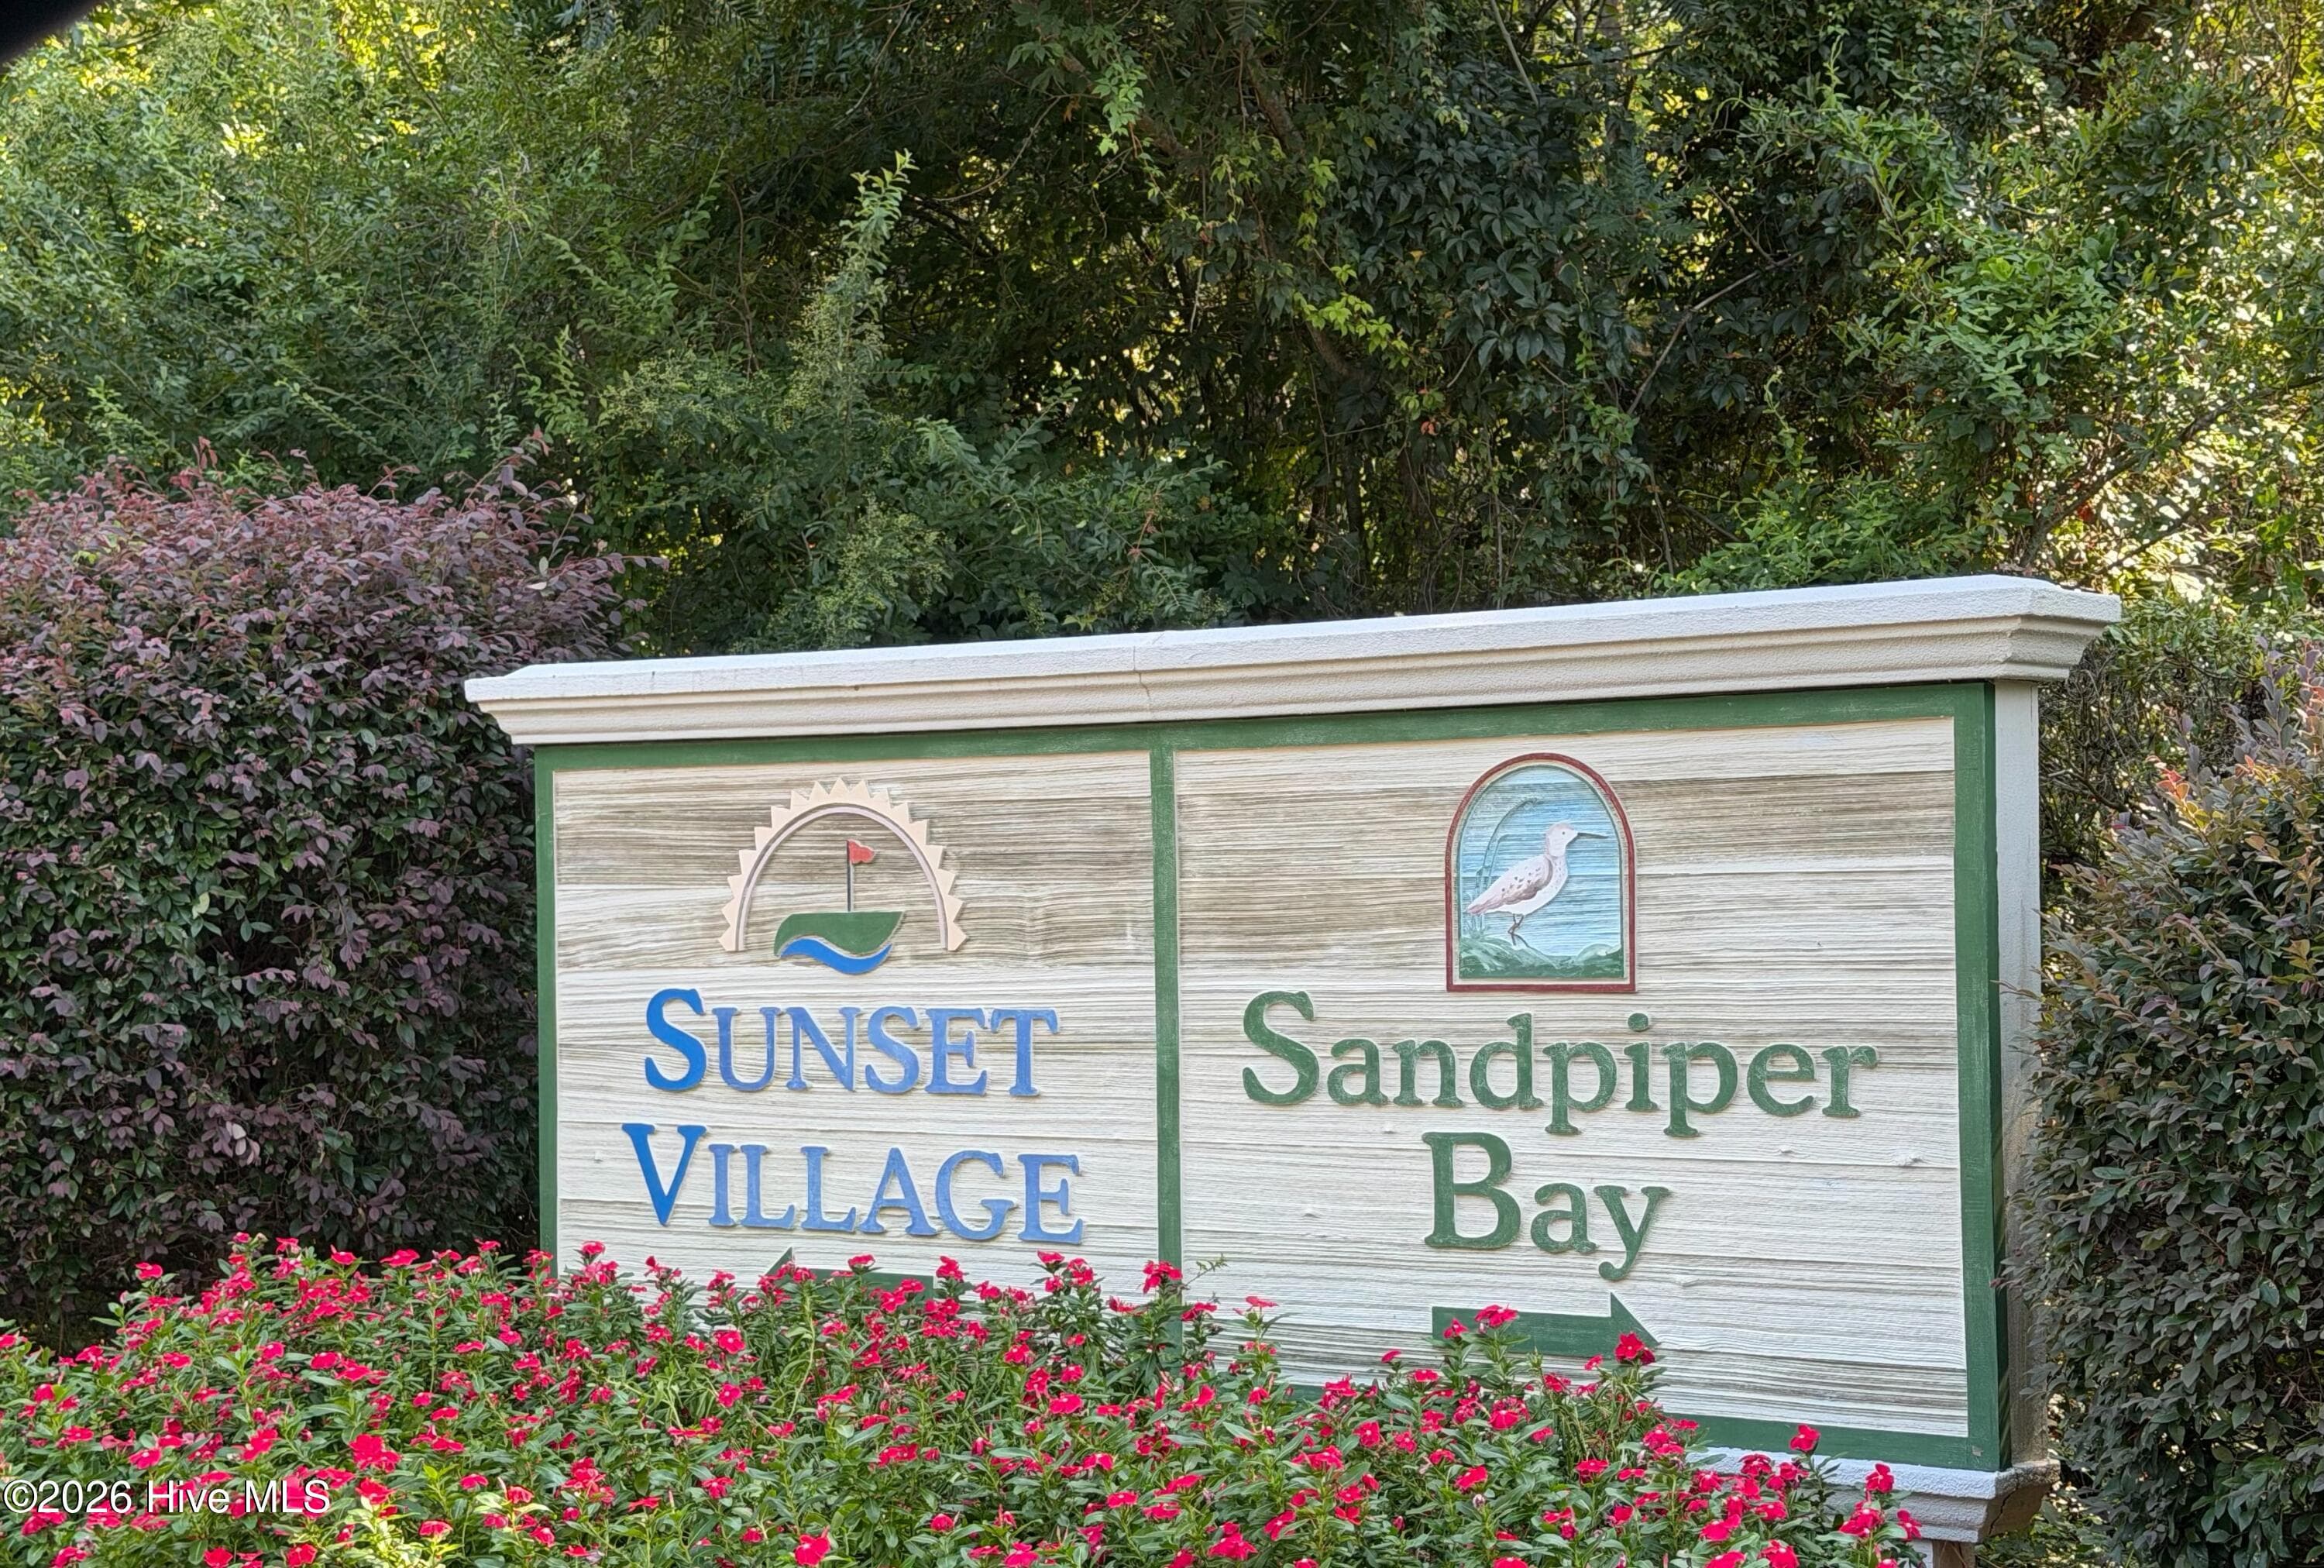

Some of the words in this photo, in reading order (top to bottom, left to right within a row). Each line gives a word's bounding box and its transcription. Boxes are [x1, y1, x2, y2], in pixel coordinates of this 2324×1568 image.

[645, 988, 1060, 1097] SUNSET
[1242, 991, 1879, 1137] Sandpiper
[622, 1123, 1084, 1244] VILLAGE
[1422, 1132, 1673, 1281] Bay
